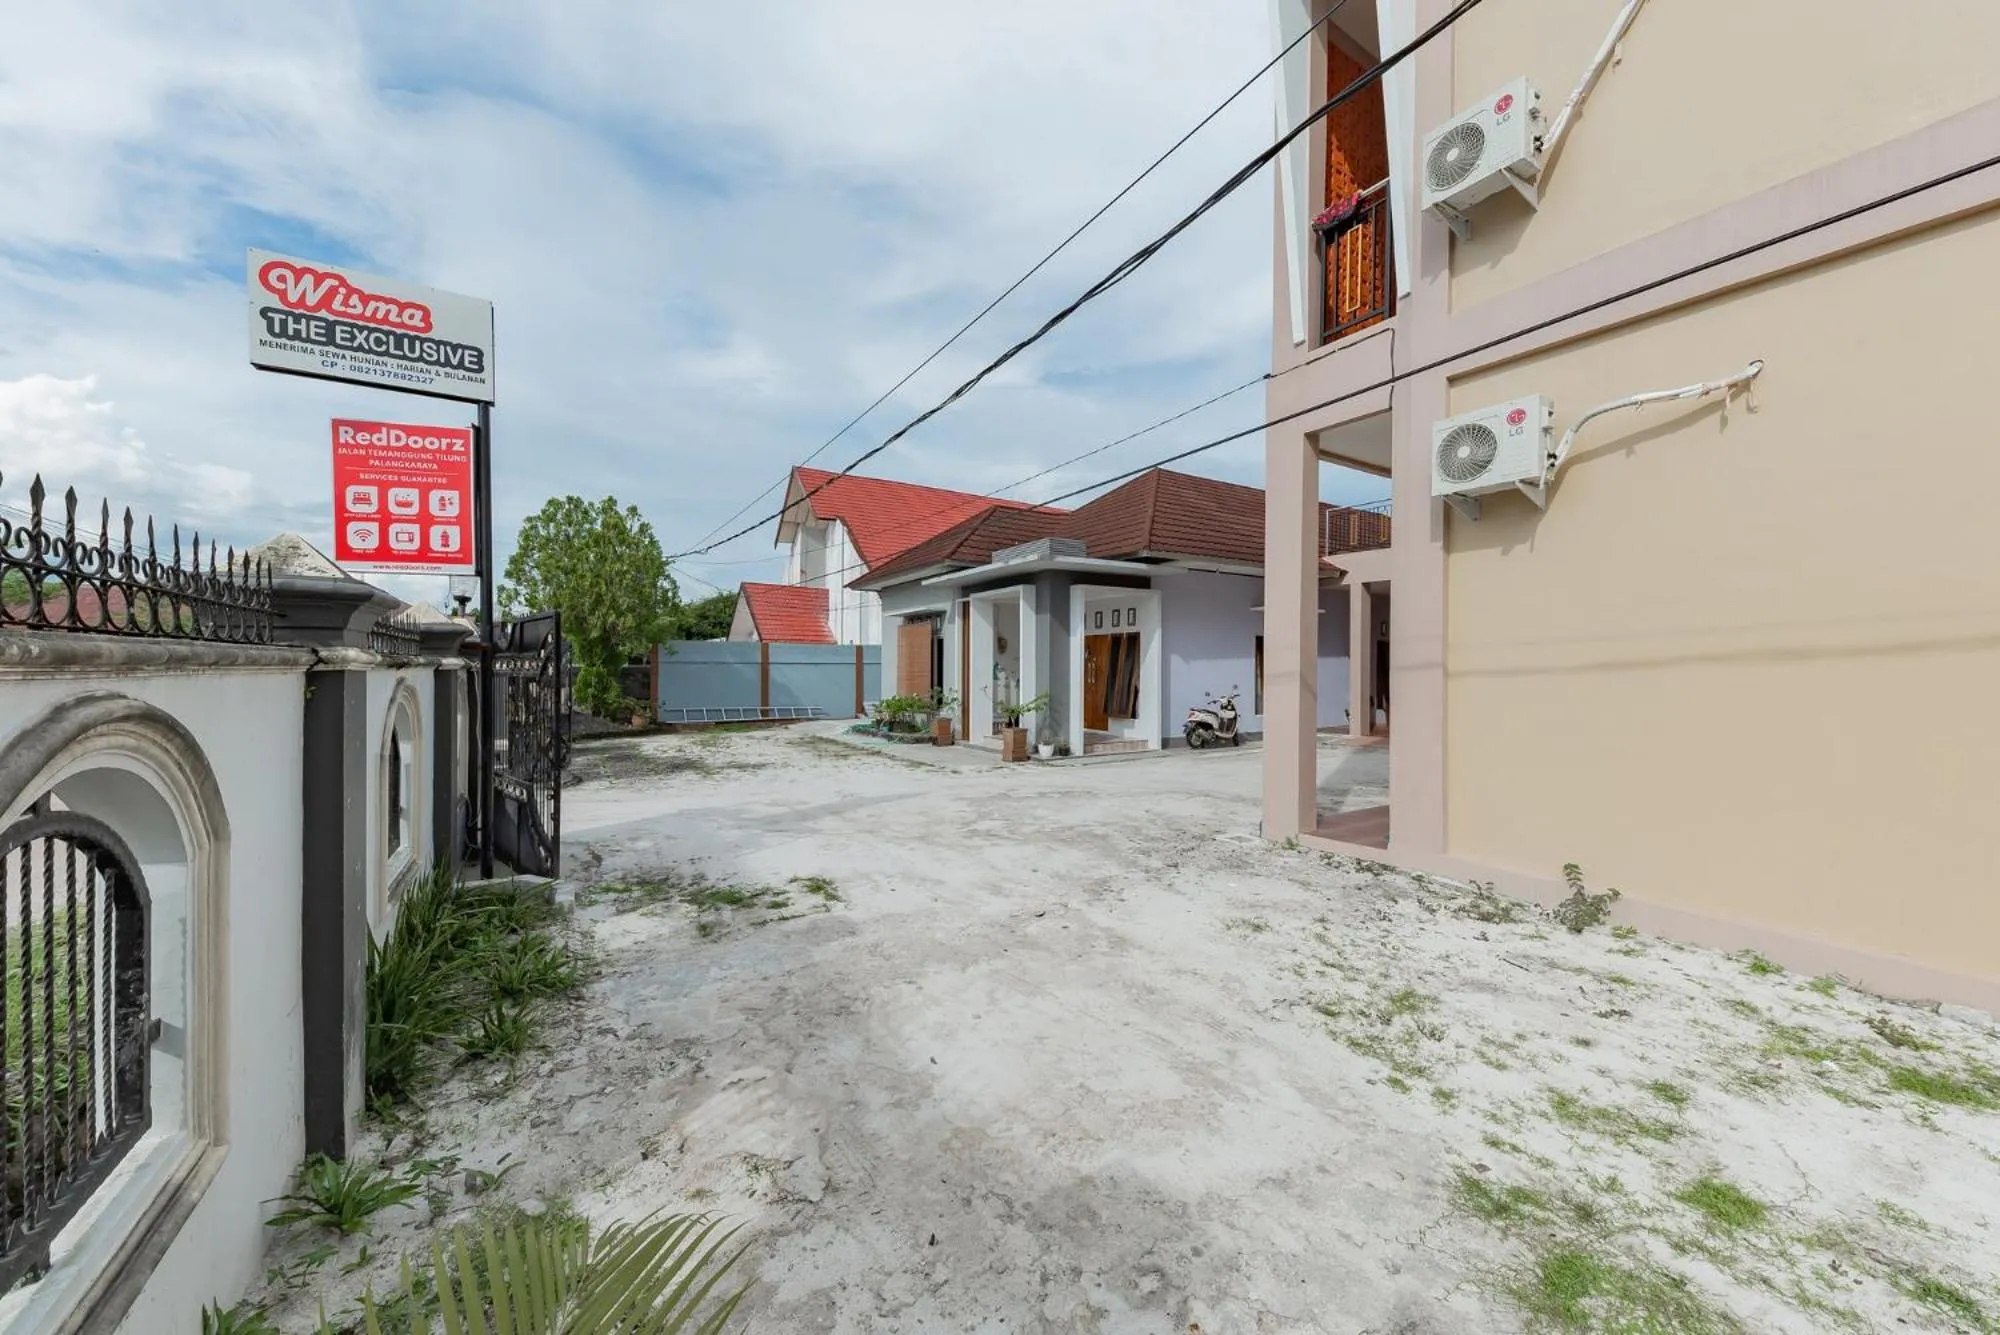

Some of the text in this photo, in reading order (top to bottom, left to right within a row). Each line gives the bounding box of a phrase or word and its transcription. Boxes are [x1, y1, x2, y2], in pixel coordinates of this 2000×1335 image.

[1496, 113, 1511, 126] LG
[267, 266, 425, 328] Wisma
[267, 312, 480, 370] THE EXCLUSIVE
[259, 339, 316, 356] MENERIMA
[319, 349, 347, 360] SEWA
[350, 354, 388, 368] HUNIAN
[396, 363, 432, 375] HARIAN
[443, 371, 486, 385] BULANAN
[321, 359, 338, 369] CP
[338, 425, 465, 451] RedDoorz
[1508, 426, 1524, 437] LG
[338, 447, 366, 457] JALAN
[368, 448, 433, 460] TEMANGGUNG
[368, 459, 438, 470] PALANGKARAYA
[359, 472, 398, 482] SERVICES
